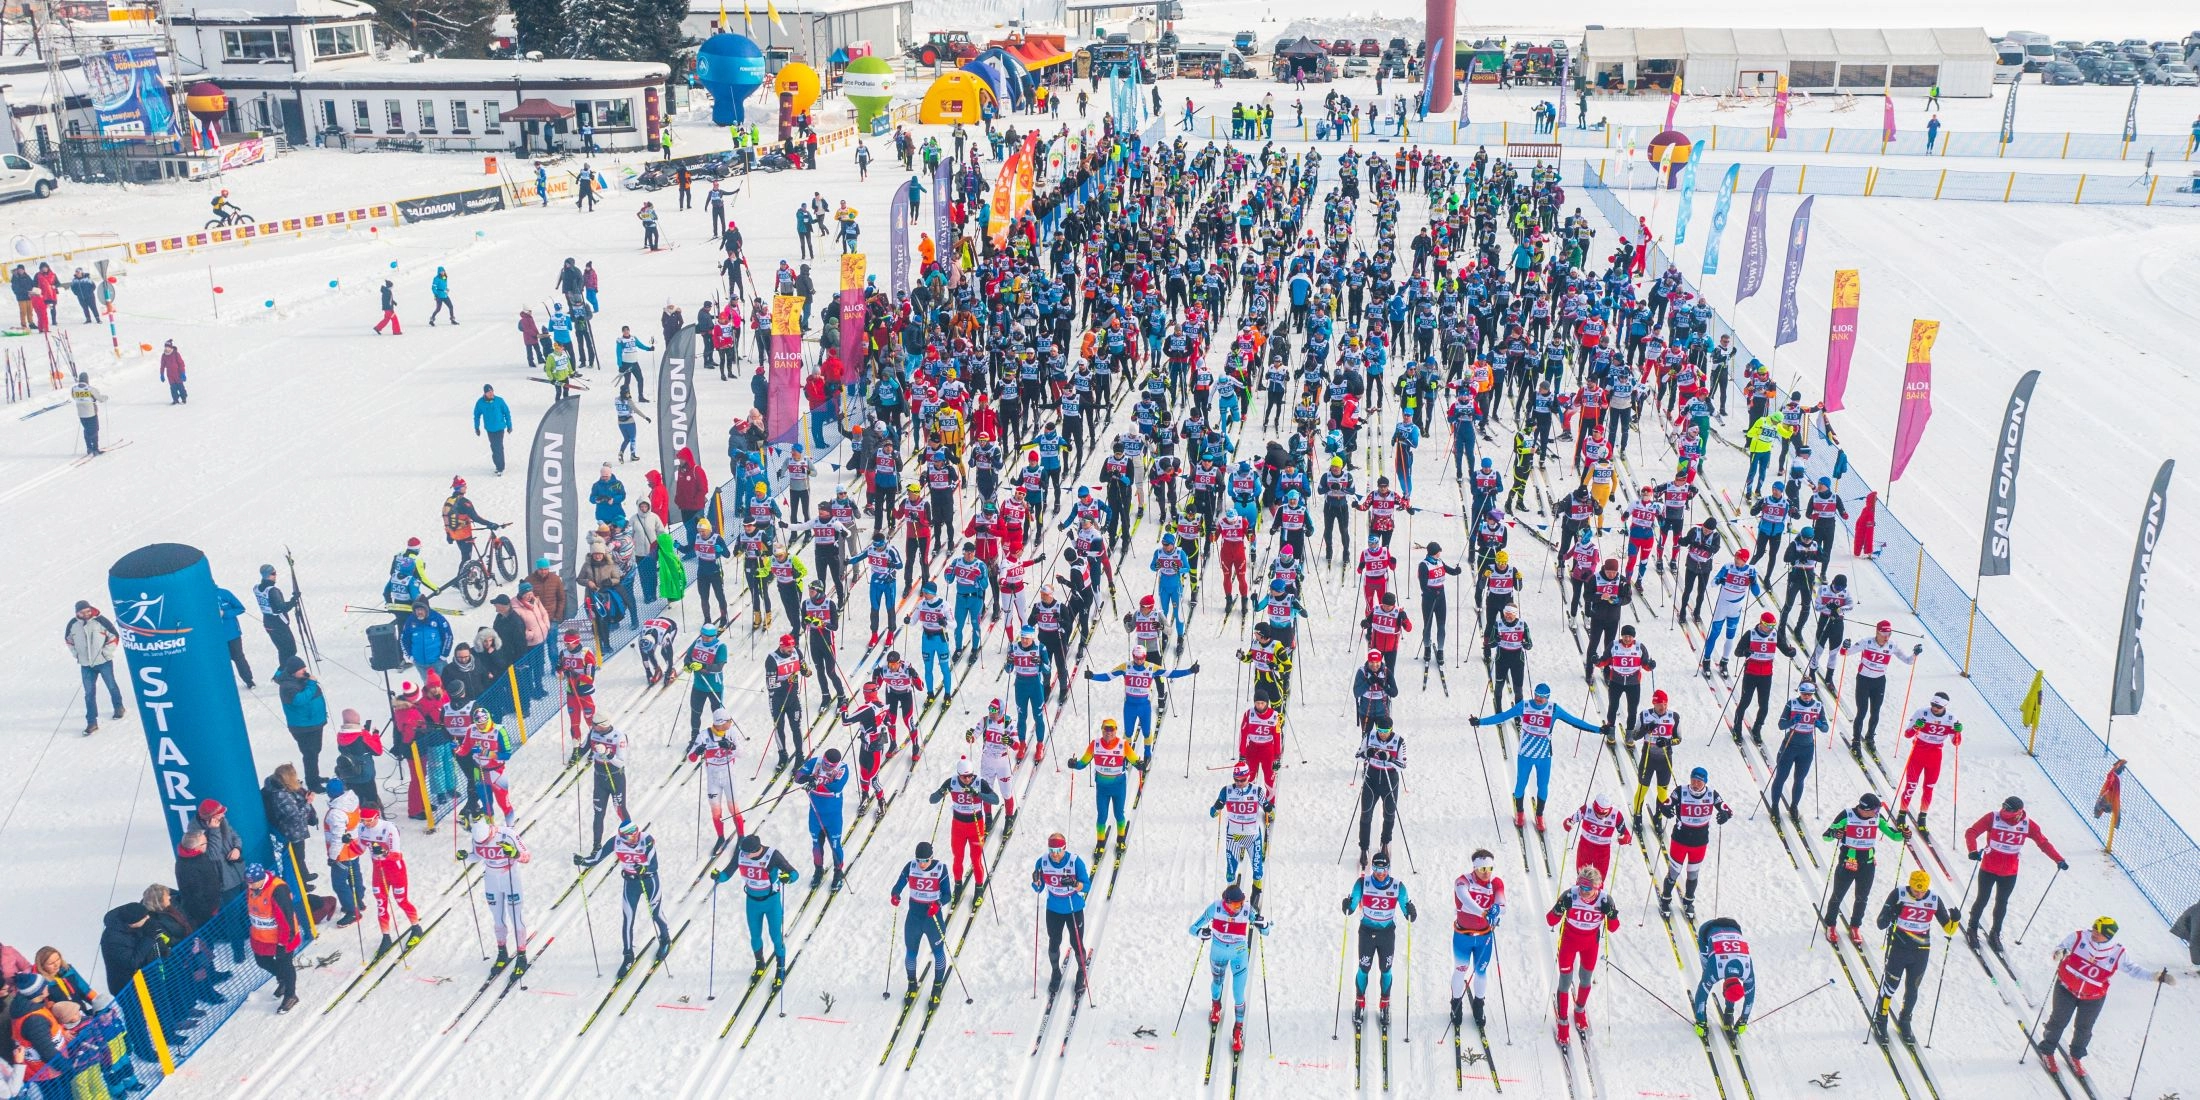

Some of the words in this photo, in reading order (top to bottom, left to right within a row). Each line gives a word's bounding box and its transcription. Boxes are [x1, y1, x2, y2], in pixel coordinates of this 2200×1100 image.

[512, 182, 568, 199] ZAKOANE
[466, 196, 500, 208] SALOMON
[844, 304, 864, 312] ALIOR
[774, 360, 799, 368] BANK
[1636, 511, 1652, 520] 119
[960, 569, 970, 578] 97
[1011, 567, 1024, 576] 109
[1434, 569, 1443, 577] 39
[392, 585, 407, 594] 542
[1042, 614, 1054, 622] 67
[1377, 616, 1393, 625] 111
[1505, 633, 1518, 641] 76
[1760, 643, 1767, 652] 8
[1871, 653, 1884, 662] 12
[784, 664, 794, 673] 17
[1129, 678, 1149, 687] 108
[451, 717, 464, 726] 49
[1529, 717, 1544, 725] 96
[1256, 726, 1270, 735] 45
[1929, 725, 1945, 735] 32
[140, 666, 196, 834] START
[1102, 756, 1116, 766] 74
[957, 794, 973, 803] 85
[1231, 804, 1254, 813] 105
[1686, 806, 1710, 815] 103
[1589, 825, 1606, 835] 37
[1856, 827, 1871, 837] 91
[1998, 831, 2023, 844] 121
[479, 848, 504, 859] 104
[748, 868, 762, 879] 81
[916, 880, 933, 890] 52
[1371, 898, 1389, 908] 23
[1474, 895, 1490, 906] 87
[1574, 911, 1602, 921] 102
[1907, 910, 1927, 920] 22
[1222, 923, 1229, 933] 1
[1722, 942, 1741, 952] 53
[2079, 960, 2099, 977] 70
